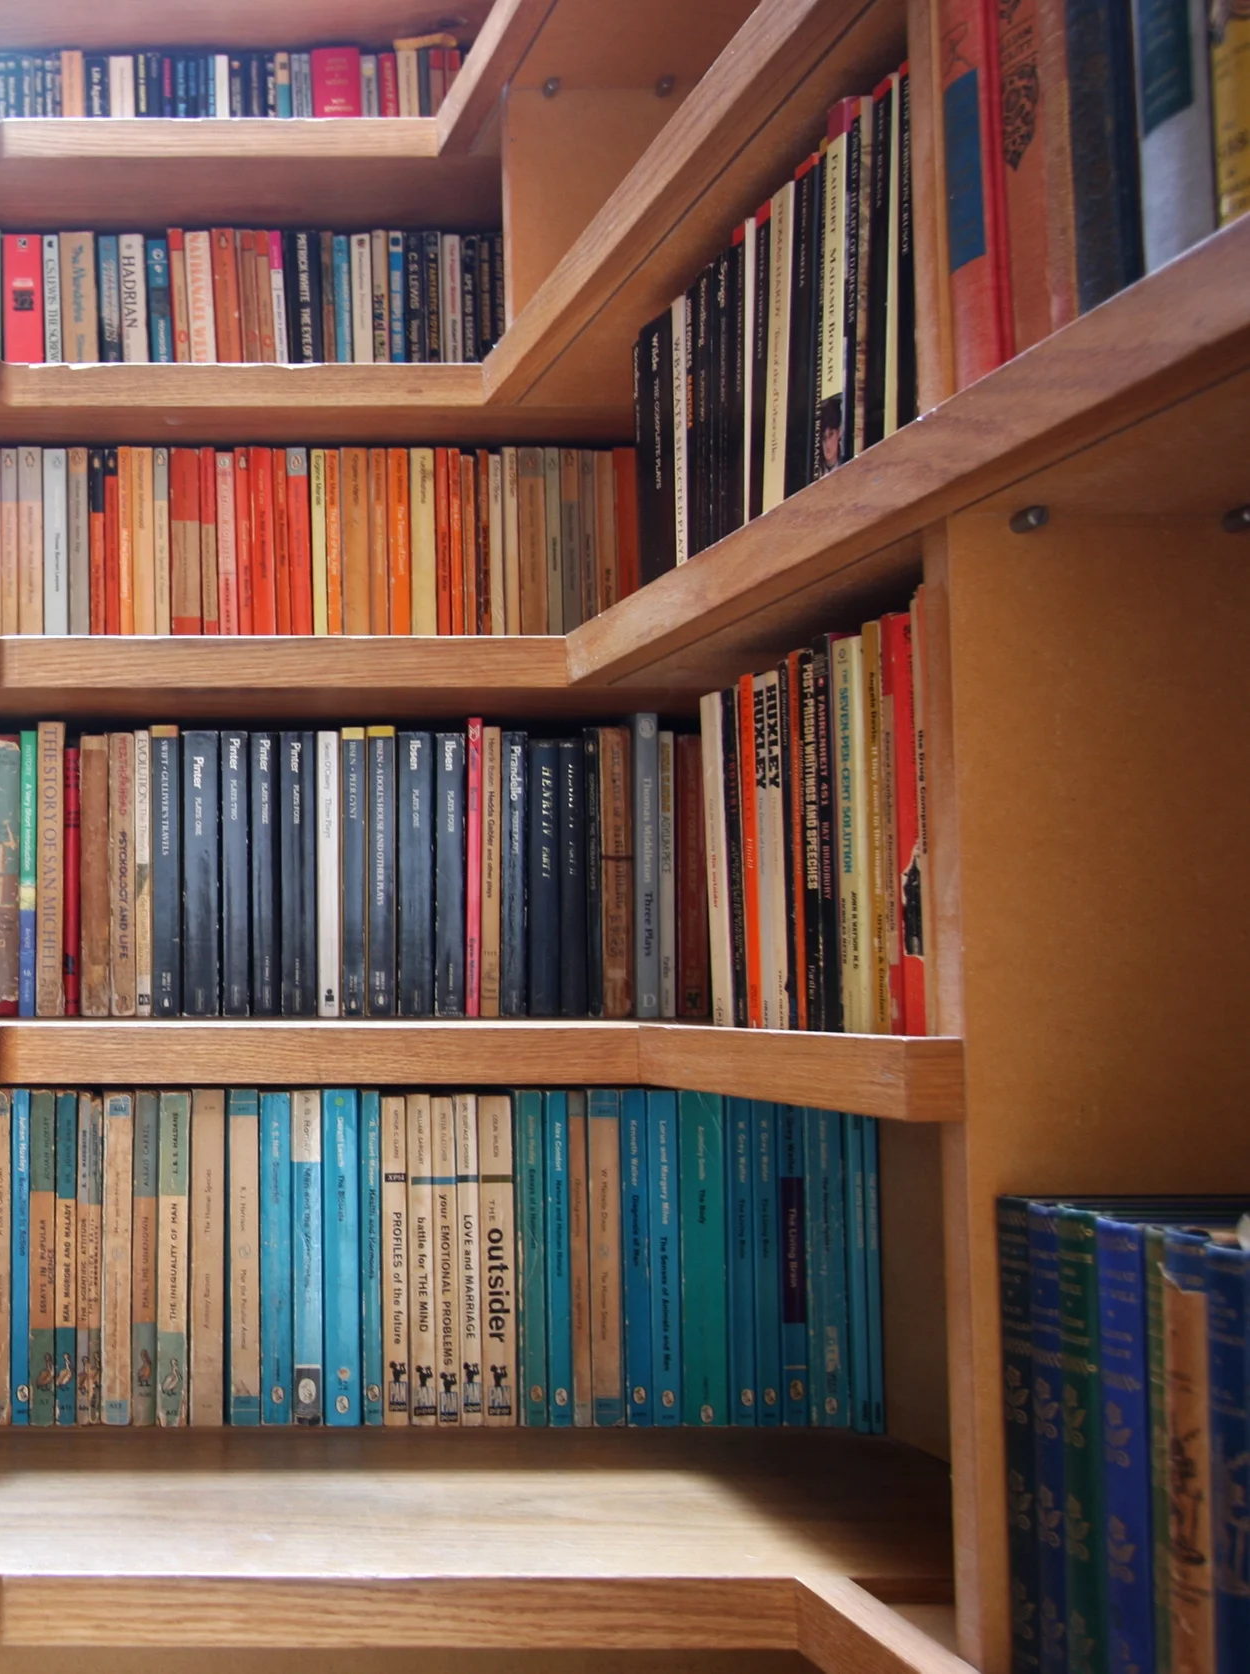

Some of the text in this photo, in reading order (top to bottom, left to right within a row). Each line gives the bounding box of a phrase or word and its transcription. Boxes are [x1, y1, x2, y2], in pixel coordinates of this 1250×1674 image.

[902, 131, 910, 201] ROBINSON
[122, 255, 137, 328] HADRIAN
[297, 233, 311, 344] PATRICK WHITE THE EYE
[409, 275, 419, 309] LEWIS
[718, 261, 728, 308] Synge
[826, 154, 839, 385] FLAUBERT MADAME BOVARY
[848, 255, 856, 324] DARKNESS
[651, 333, 660, 372] Wilde
[137, 738, 148, 804] EVOLUTION
[193, 756, 204, 789] Pinter
[230, 737, 241, 771] Pinter
[259, 738, 270, 773] Pinter
[290, 742, 301, 773] Pinter
[409, 740, 421, 771] Ibsen
[444, 740, 456, 772] Ibsen
[510, 745, 521, 802] Pirandello
[752, 690, 766, 790] HUXLEY
[765, 684, 780, 788] HUXLEY
[802, 664, 818, 890] POST-PRISON WRITINGS AND SPEECHES
[838, 687, 855, 874] SEVEN-PER-CENT SOLUTION
[161, 740, 169, 856] SWIFT GULLIVER'S TRAVELS
[487, 791, 496, 846] Hedda Gabler
[817, 695, 832, 899] FAHRENHEIT 451 BRADBURY
[41, 727, 58, 974] THE STORY OF SAN MICHELE
[118, 831, 129, 960] PSYCHOLOGY AND LIFE
[642, 777, 654, 958] Thomas Middleton Three Plays
[170, 1203, 178, 1321] THE INEQUALITY OF MAN
[393, 1212, 403, 1345] PROFILES of the future
[418, 1217, 429, 1333] battle for THE MIND
[438, 1194, 453, 1366] your EMOTIONAL PROBLEMS
[463, 1214, 476, 1340] LOVE and MARRIAGE
[487, 1200, 510, 1343] THE outsider
[787, 1229, 797, 1288] Living Brain
